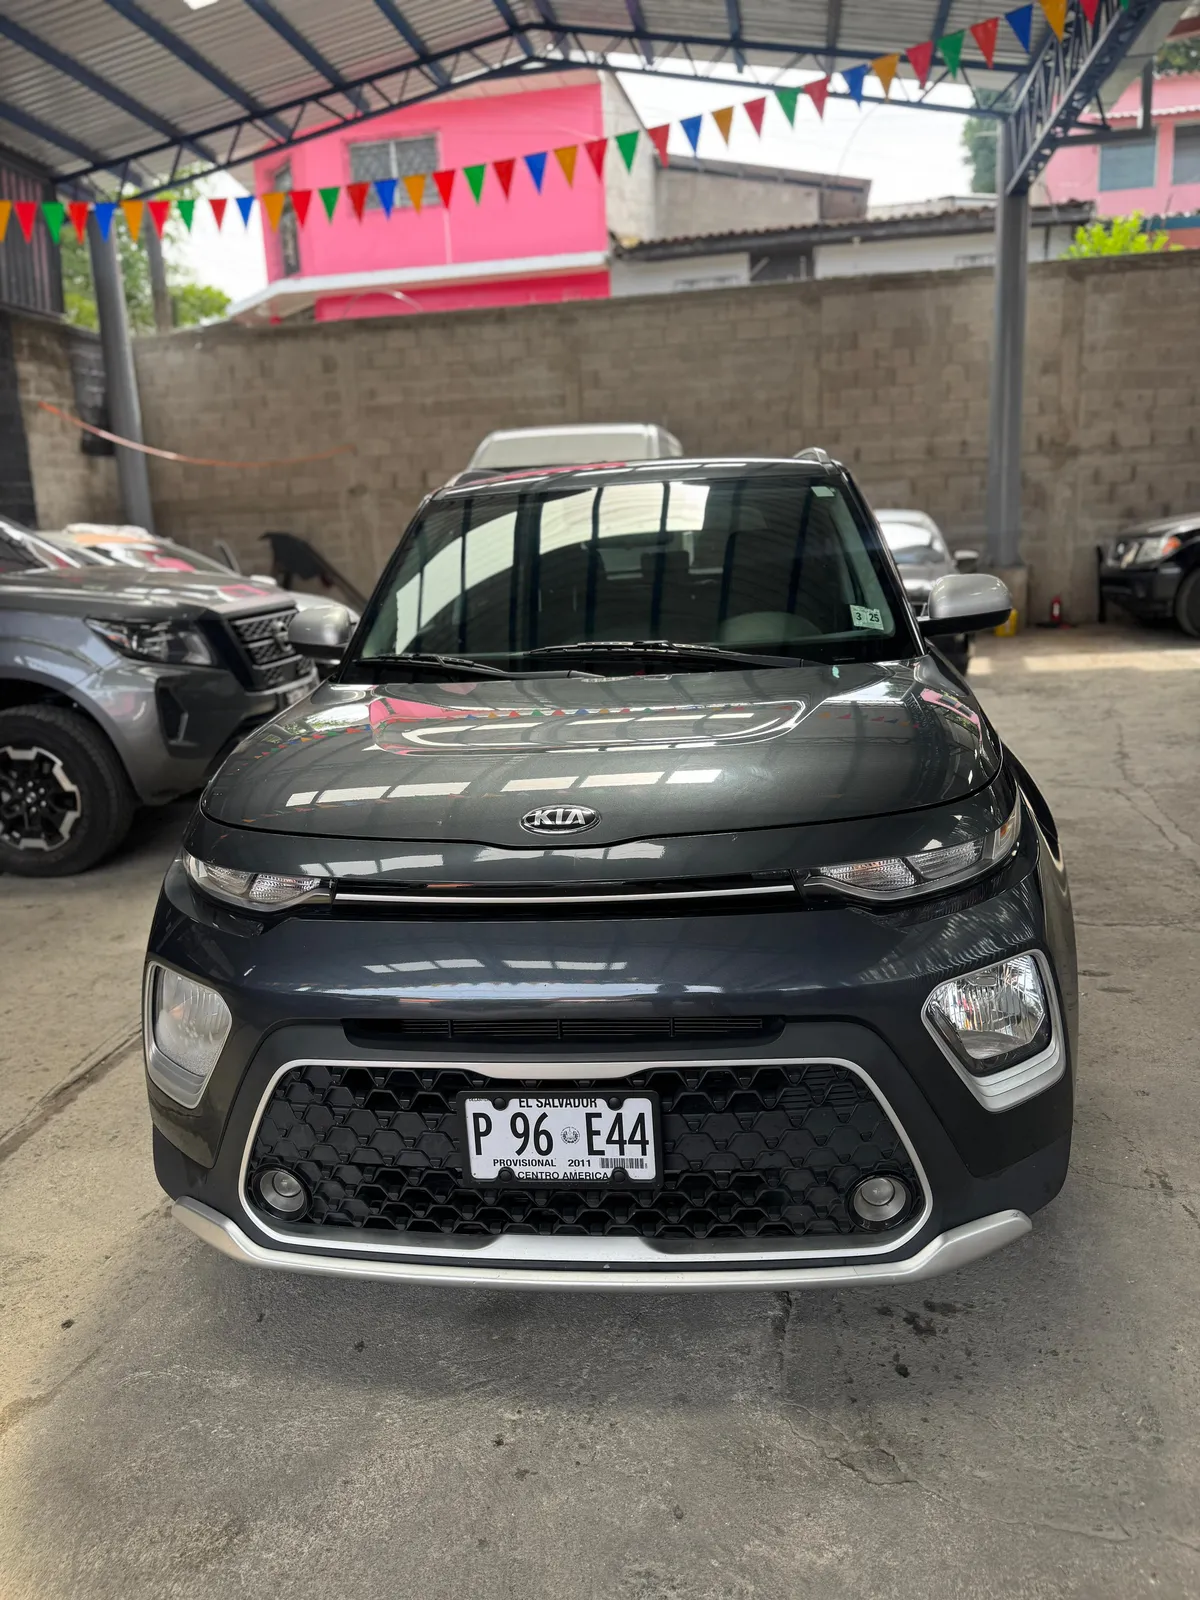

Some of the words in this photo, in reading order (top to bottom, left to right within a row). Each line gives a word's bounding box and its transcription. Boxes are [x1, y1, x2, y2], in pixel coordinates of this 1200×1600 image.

[855, 612, 862, 621] 3
[868, 613, 880, 623] 25
[534, 808, 586, 826] KIA
[519, 1098, 533, 1109] EL
[536, 1098, 598, 1109] SALVADOR
[472, 1112, 493, 1156] P
[510, 1112, 554, 1156] 96
[585, 1112, 650, 1156] E44
[493, 1158, 557, 1167] PROVISIONAL
[567, 1159, 591, 1167] 2011
[517, 1171, 560, 1180] CENTRO
[562, 1171, 610, 1180] AMERICA
